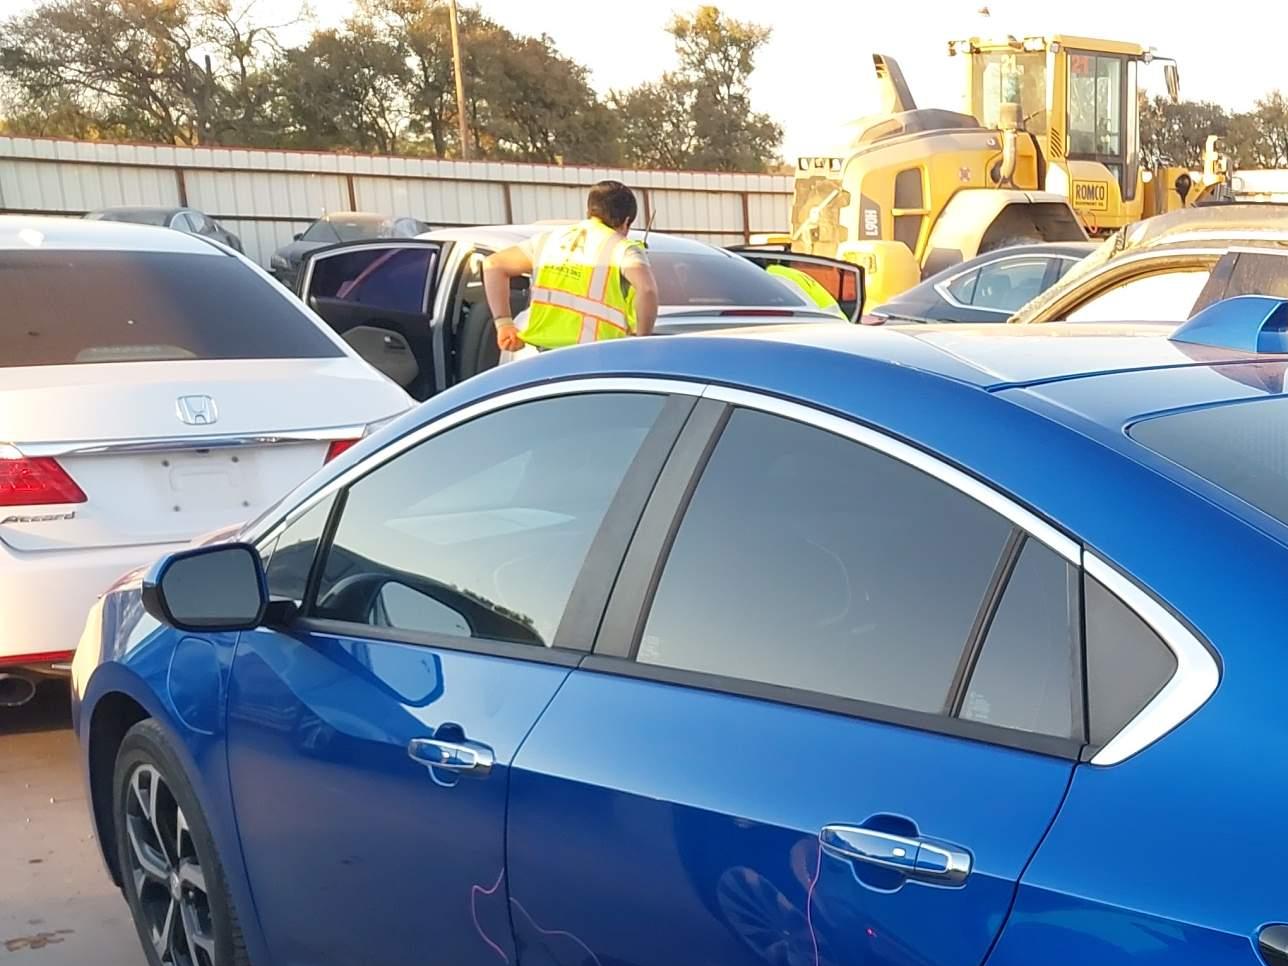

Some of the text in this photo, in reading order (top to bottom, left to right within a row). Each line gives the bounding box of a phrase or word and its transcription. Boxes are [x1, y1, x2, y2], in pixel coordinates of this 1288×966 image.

[1075, 184, 1105, 201] ROMCO
[864, 208, 879, 236] L90H
[0, 511, 77, 525] Accord
